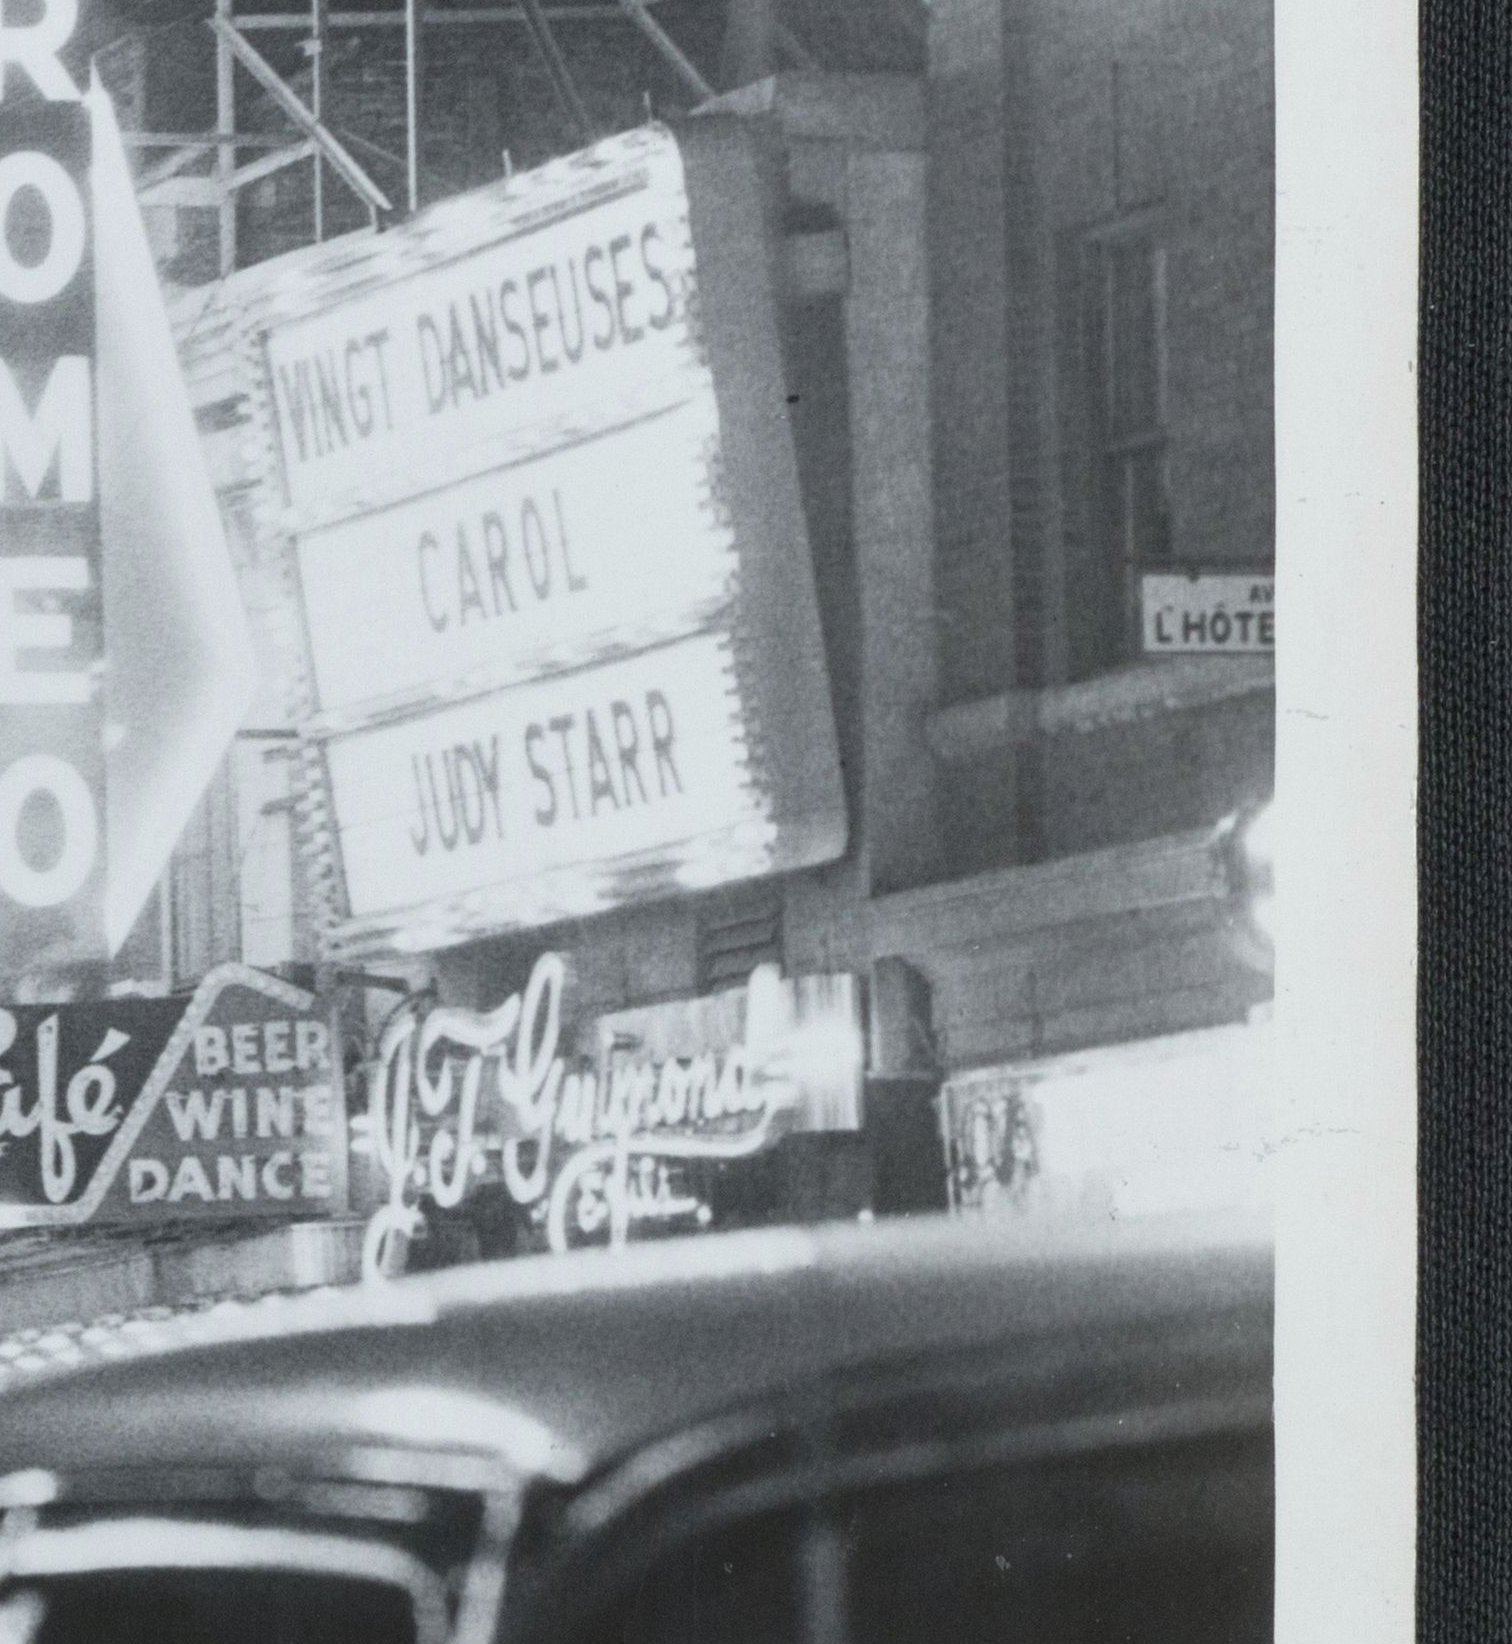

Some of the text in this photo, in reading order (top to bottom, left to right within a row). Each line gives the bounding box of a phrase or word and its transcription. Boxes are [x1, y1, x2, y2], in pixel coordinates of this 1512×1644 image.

[276, 222, 673, 463] VINGT DANSEUSES
[416, 488, 590, 634] CAROL
[410, 689, 686, 858] JUDY STARR
[195, 1020, 332, 1076] BEER
[167, 1085, 333, 1142] WINE
[129, 1154, 333, 1203] DANCE
